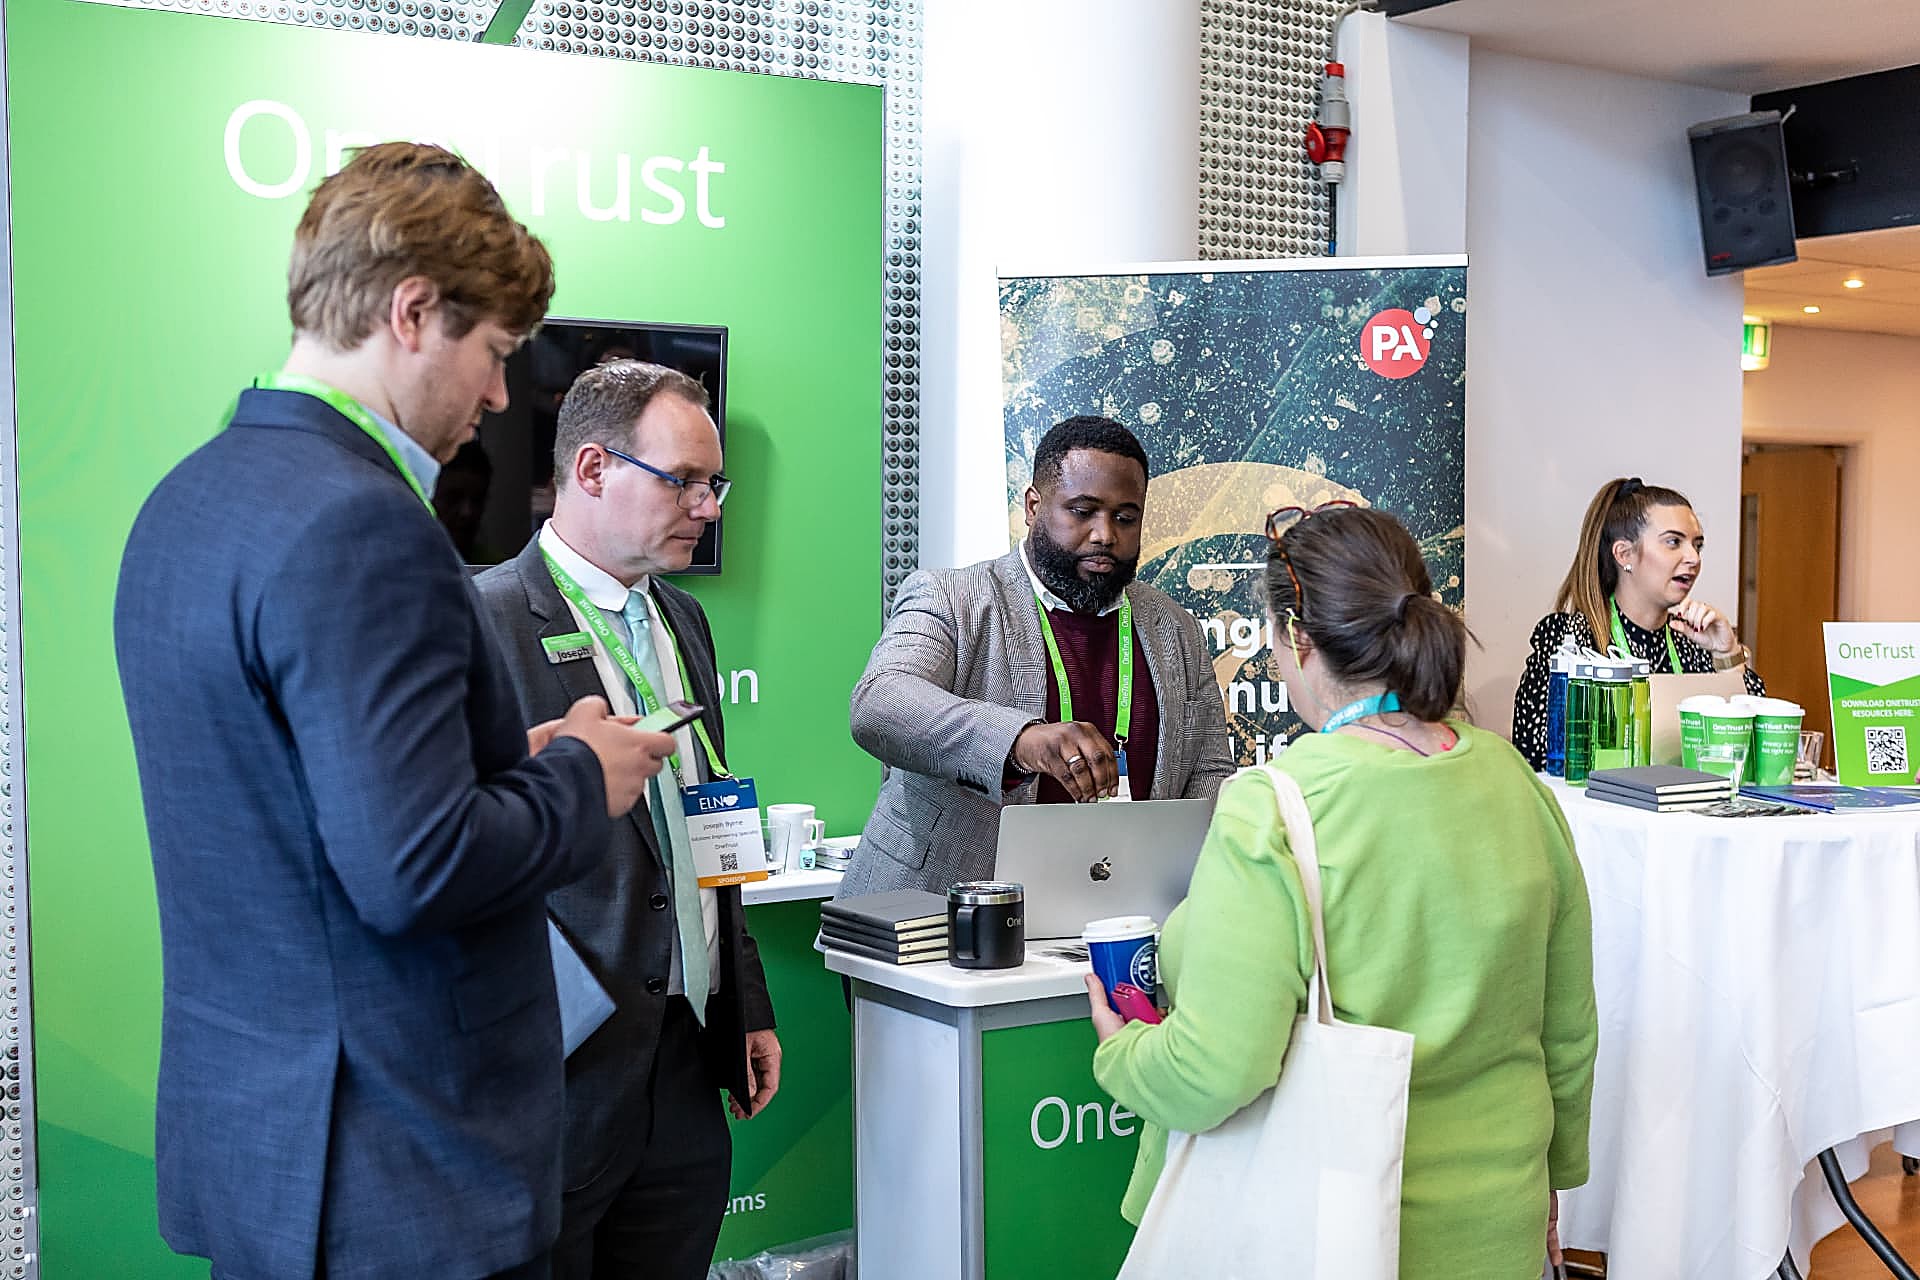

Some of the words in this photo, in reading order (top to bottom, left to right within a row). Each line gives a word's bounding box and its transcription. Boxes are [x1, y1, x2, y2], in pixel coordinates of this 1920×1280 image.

[1372, 325, 1423, 361] PA
[556, 646, 590, 662] Joseph
[1838, 642, 1915, 660] OneTrust
[1841, 699, 1884, 709] DOWNLOAD
[698, 795, 724, 811] ELN
[1030, 1096, 1136, 1149] One
